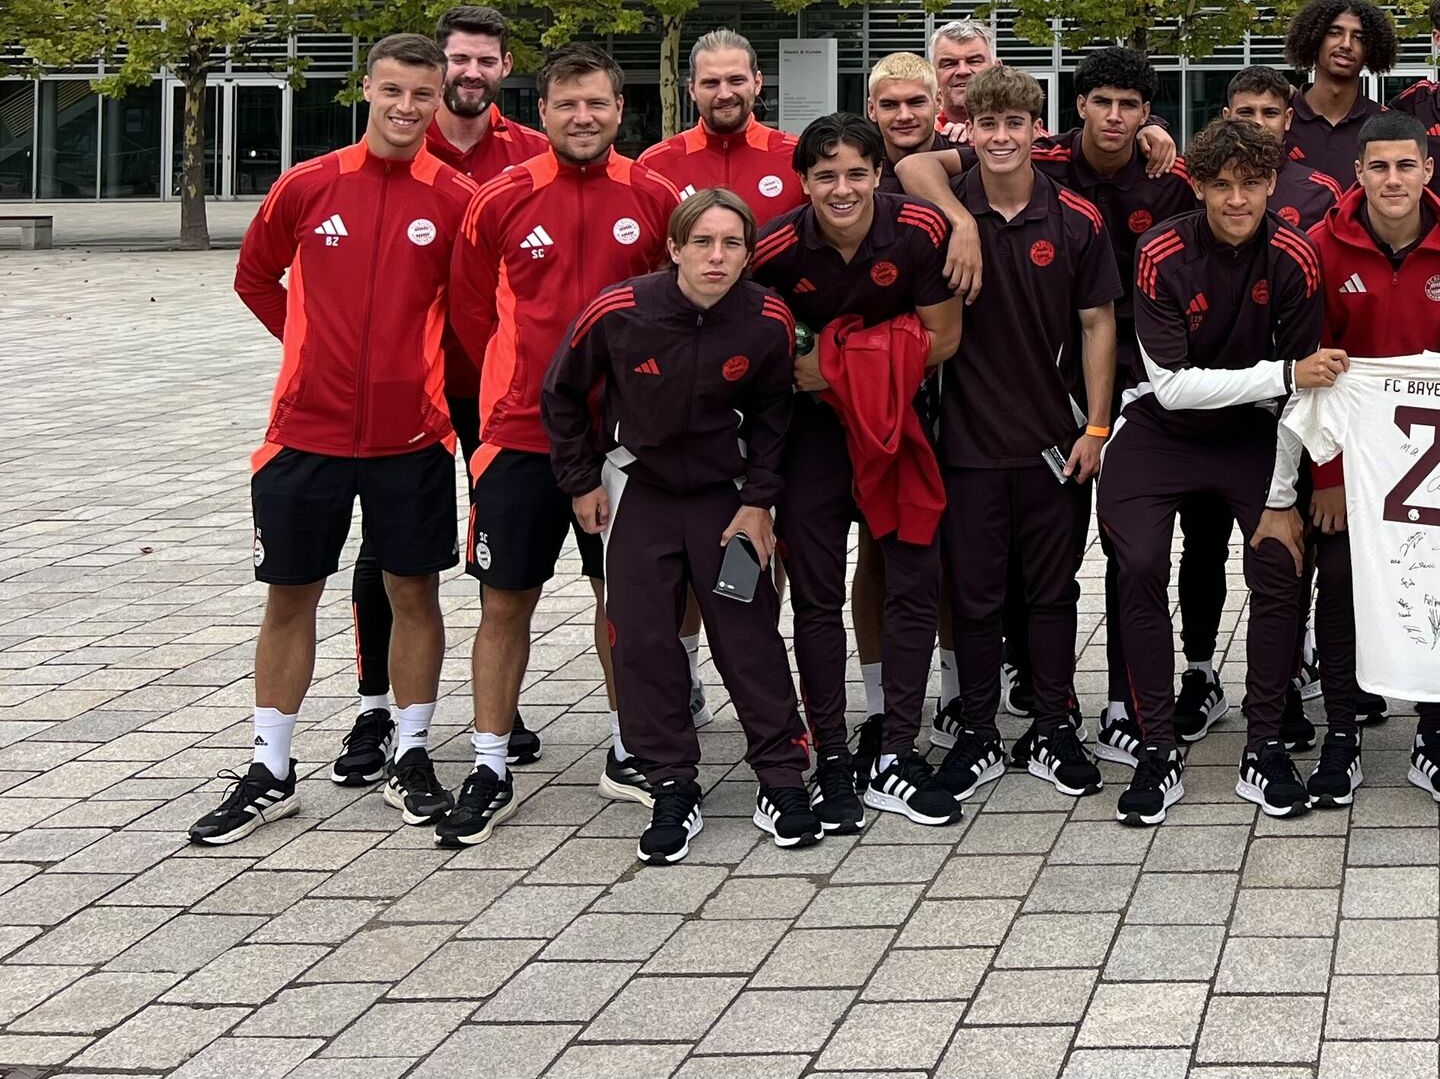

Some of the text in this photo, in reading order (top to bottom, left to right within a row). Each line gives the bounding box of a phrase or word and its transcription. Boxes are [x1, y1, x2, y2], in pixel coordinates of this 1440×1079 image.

[325, 236, 339, 247] BZ
[531, 249, 545, 259] SC
[1384, 379, 1401, 393] FC
